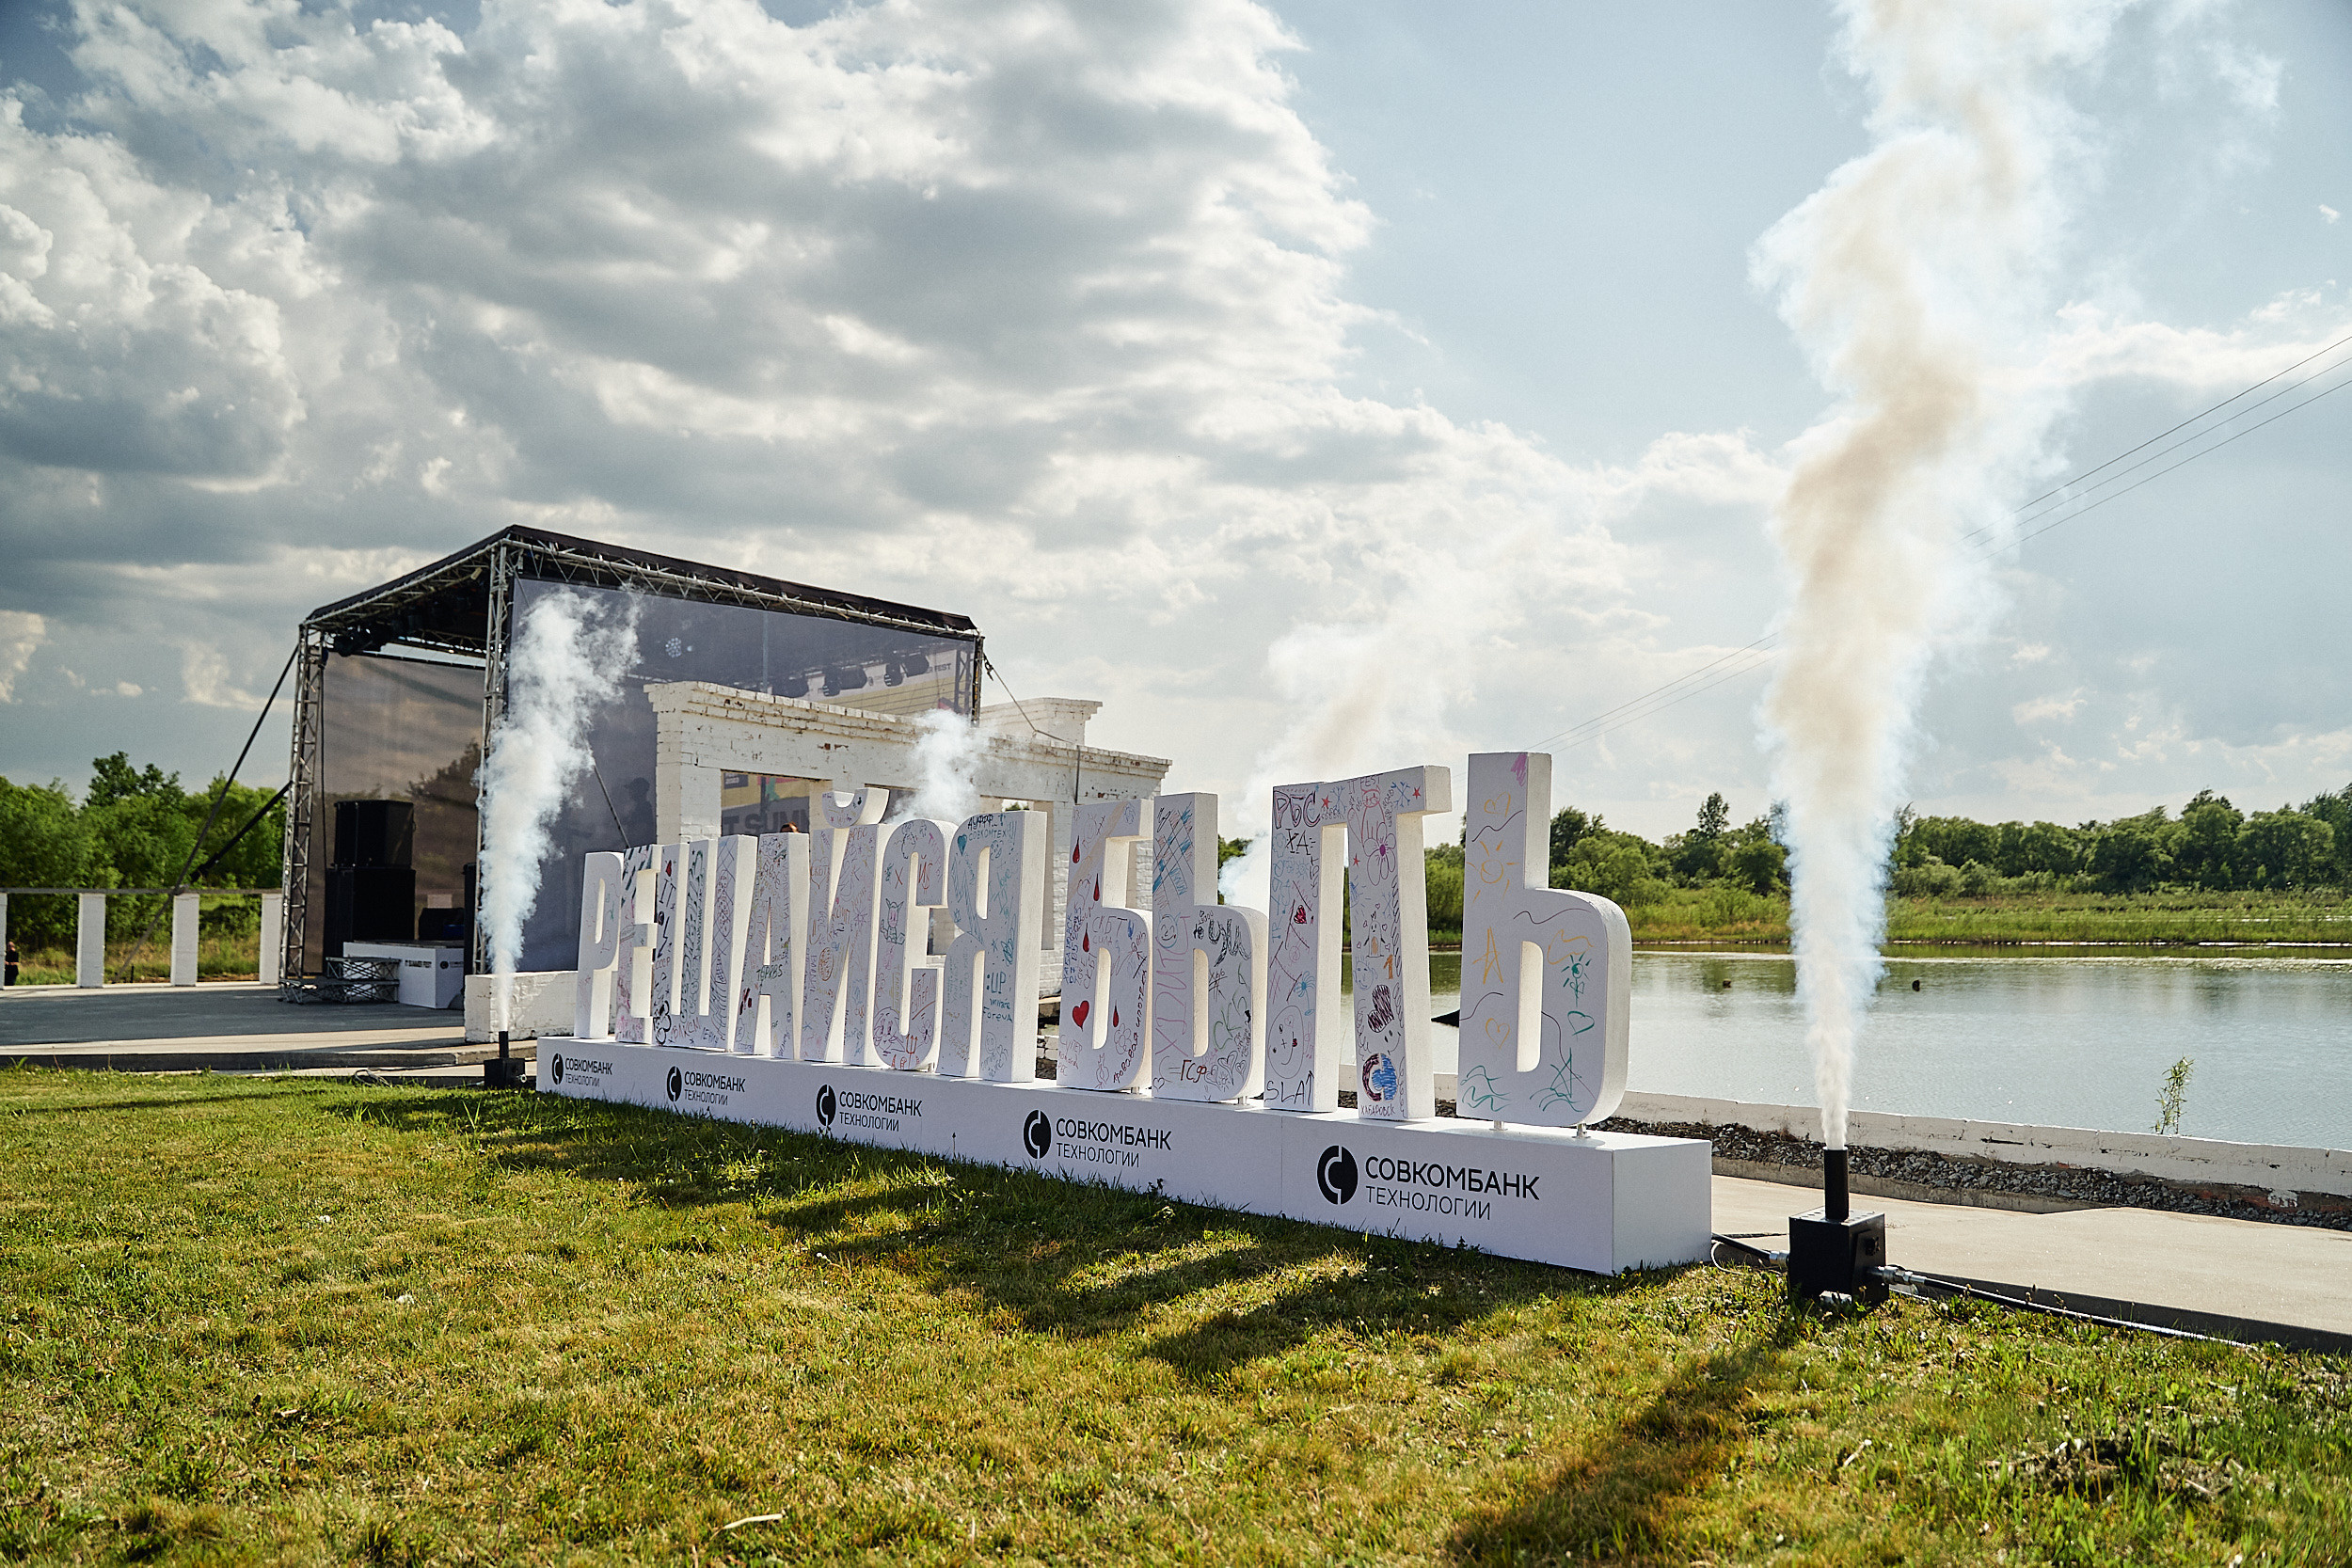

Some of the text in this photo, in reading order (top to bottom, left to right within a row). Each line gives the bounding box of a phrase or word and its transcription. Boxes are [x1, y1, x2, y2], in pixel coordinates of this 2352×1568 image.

[565, 1057, 612, 1075] СОВКОМБАНК
[565, 1073, 600, 1087] ТЕХНОЛОГИИ
[684, 1071, 746, 1092] СОВКОМБАНК
[684, 1088, 728, 1105] ТЕХНОЛОГИИ
[839, 1091, 923, 1117] СОВКОМБАНК
[839, 1112, 899, 1132] ТЕХНОЛОГИИ
[1056, 1117, 1172, 1150] СОВКОМБАНК
[1056, 1142, 1140, 1168] ТЕХНОЛОГИИ
[1365, 1156, 1540, 1200] СОВКОМБАНК
[1366, 1186, 1491, 1220] ТЕХНОЛОГИИ
